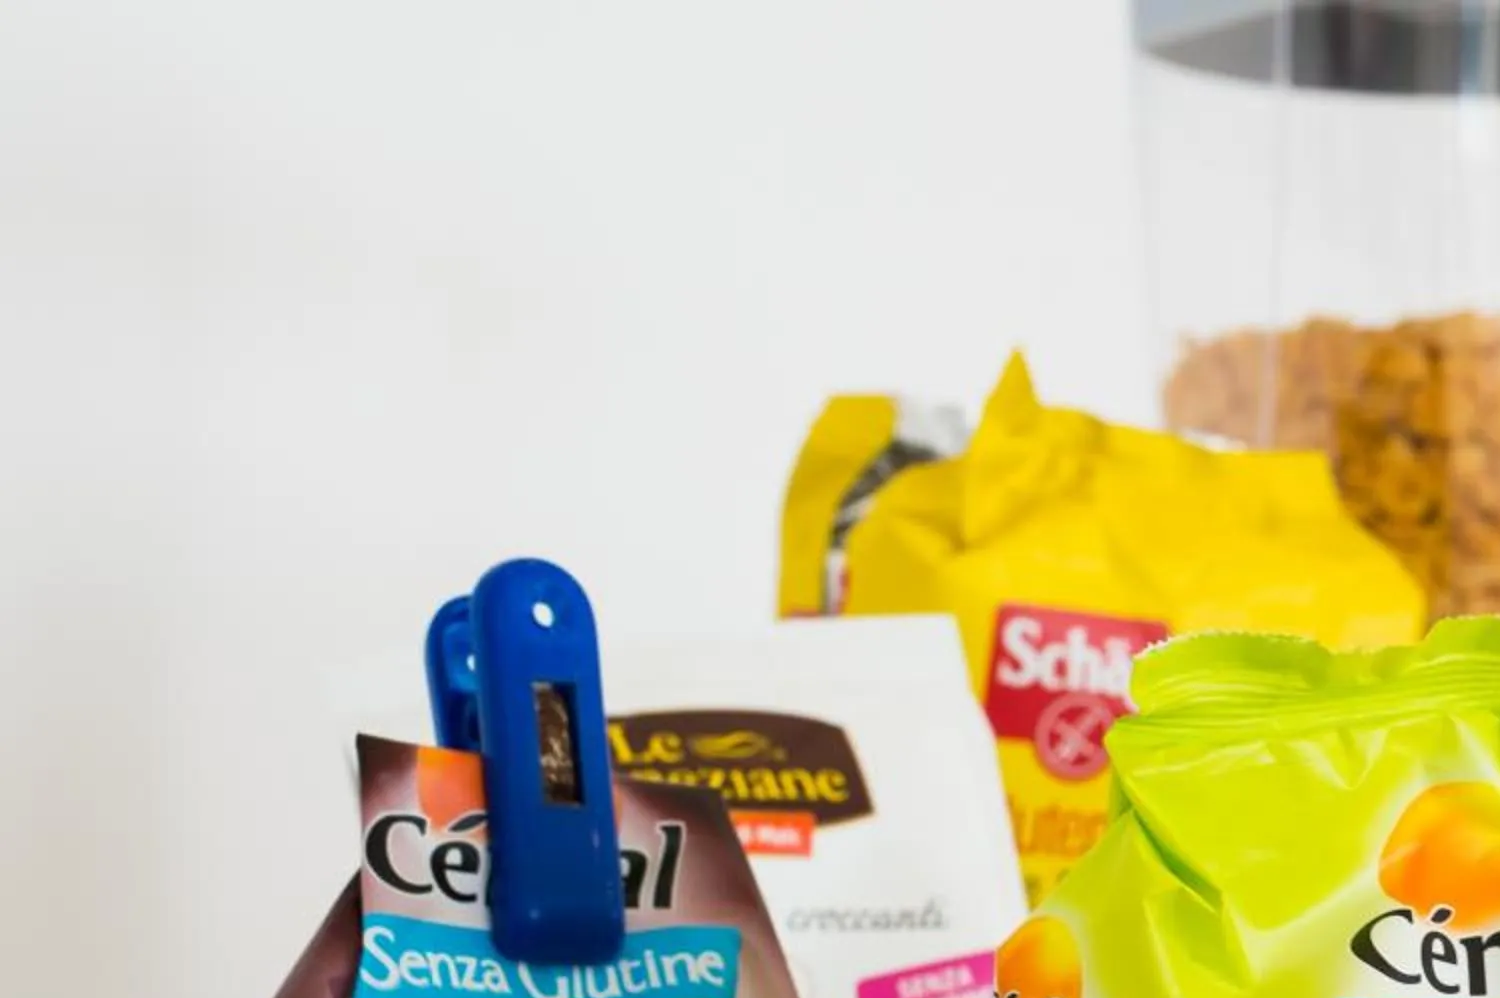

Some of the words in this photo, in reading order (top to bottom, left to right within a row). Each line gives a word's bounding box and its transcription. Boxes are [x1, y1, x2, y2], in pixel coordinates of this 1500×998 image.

[996, 616, 1134, 700] Schä
[608, 722, 684, 764] Le
[365, 813, 688, 909] Céal
[360, 925, 510, 994] Senza
